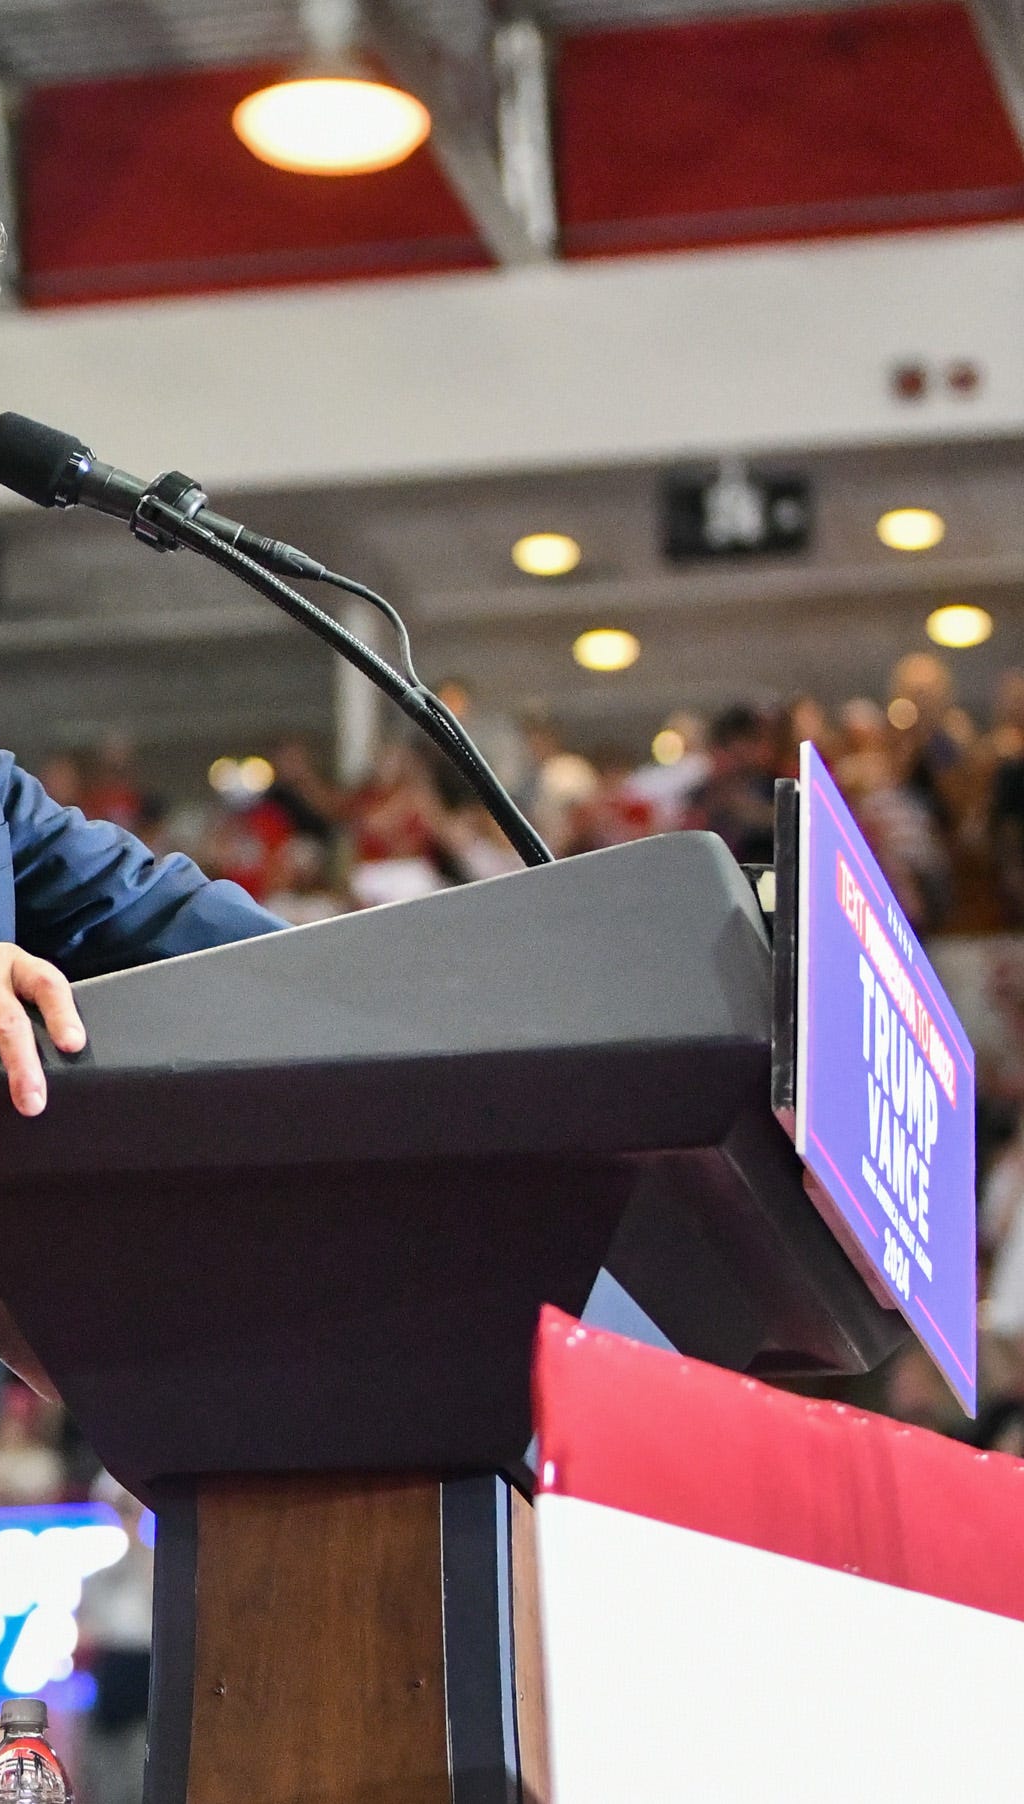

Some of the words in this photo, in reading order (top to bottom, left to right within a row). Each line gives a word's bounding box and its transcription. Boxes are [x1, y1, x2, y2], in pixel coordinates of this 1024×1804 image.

[840, 860, 865, 938] TEXT
[916, 997, 929, 1054] TO
[859, 952, 938, 1165] TRUMP
[867, 1071, 930, 1244] VANCE
[883, 1226, 910, 1302] 2024
